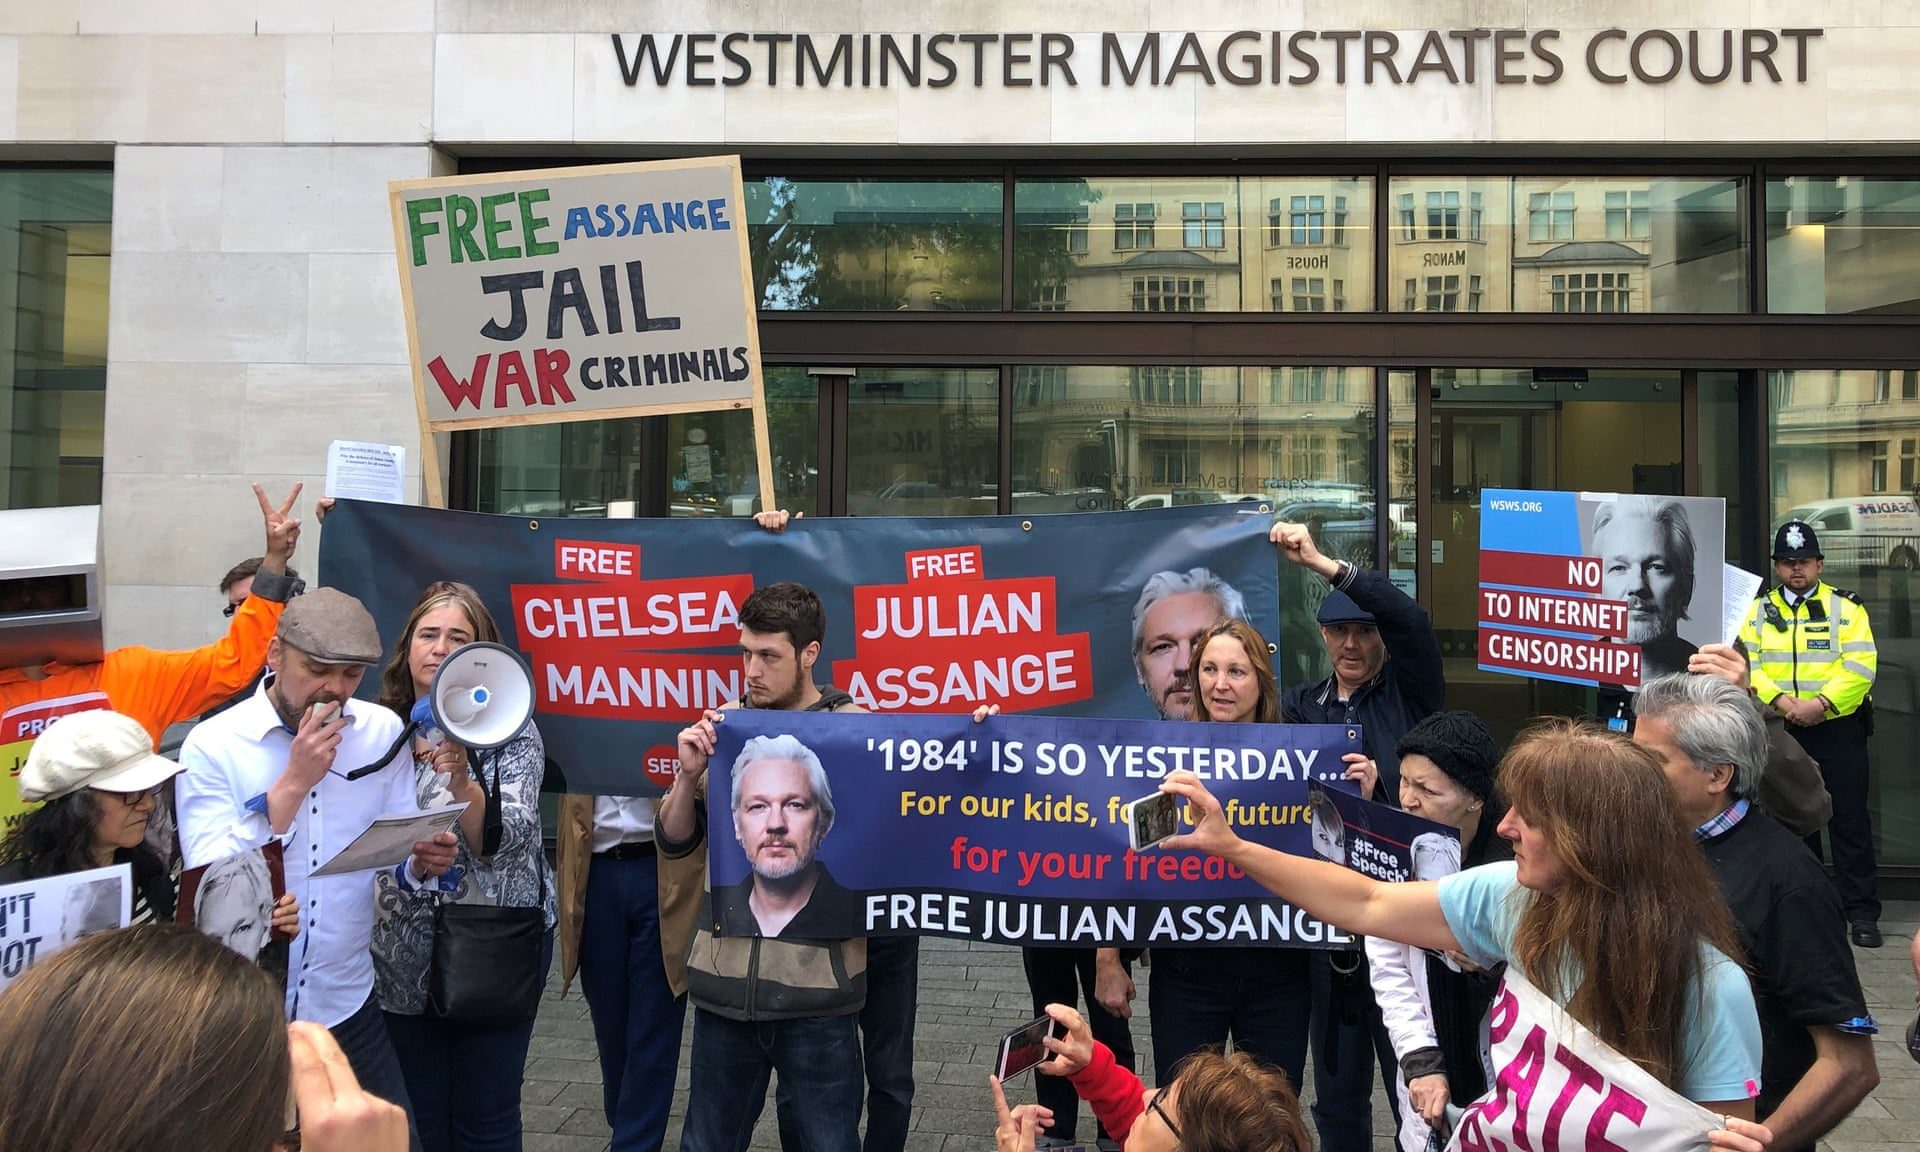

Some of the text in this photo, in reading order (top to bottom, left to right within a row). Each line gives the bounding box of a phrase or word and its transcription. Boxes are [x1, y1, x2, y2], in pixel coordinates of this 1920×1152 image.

[611, 28, 1824, 87] WESTMINSTER MAGISTRATES COURT
[406, 188, 731, 266] FREE ASSANGE
[480, 260, 681, 341] JAIL
[427, 347, 749, 412] WAR CRIMINALS
[1490, 499, 1543, 513] WSWS.ORG
[561, 546, 633, 576] FREE
[911, 551, 976, 579] FREE
[1568, 560, 1601, 588] NO
[524, 590, 743, 639] CHELSEA
[861, 591, 1042, 640] JULIAN
[1484, 592, 1628, 632] TO INTERNET
[1488, 634, 1639, 678] CENSORSHIP!
[546, 662, 751, 709] MANNIN
[848, 649, 1077, 711] ASSANGE
[866, 738, 977, 772] '1984'
[991, 741, 1024, 774] IS
[1035, 742, 1087, 776] SO
[900, 791, 951, 817] For
[960, 795, 1015, 819] our
[1024, 792, 1098, 828] kids,
[951, 836, 1007, 874] for
[1018, 851, 1110, 886] your
[1354, 838, 1399, 868] #Free
[866, 893, 971, 934] FREE
[982, 900, 1136, 942] JULIAN
